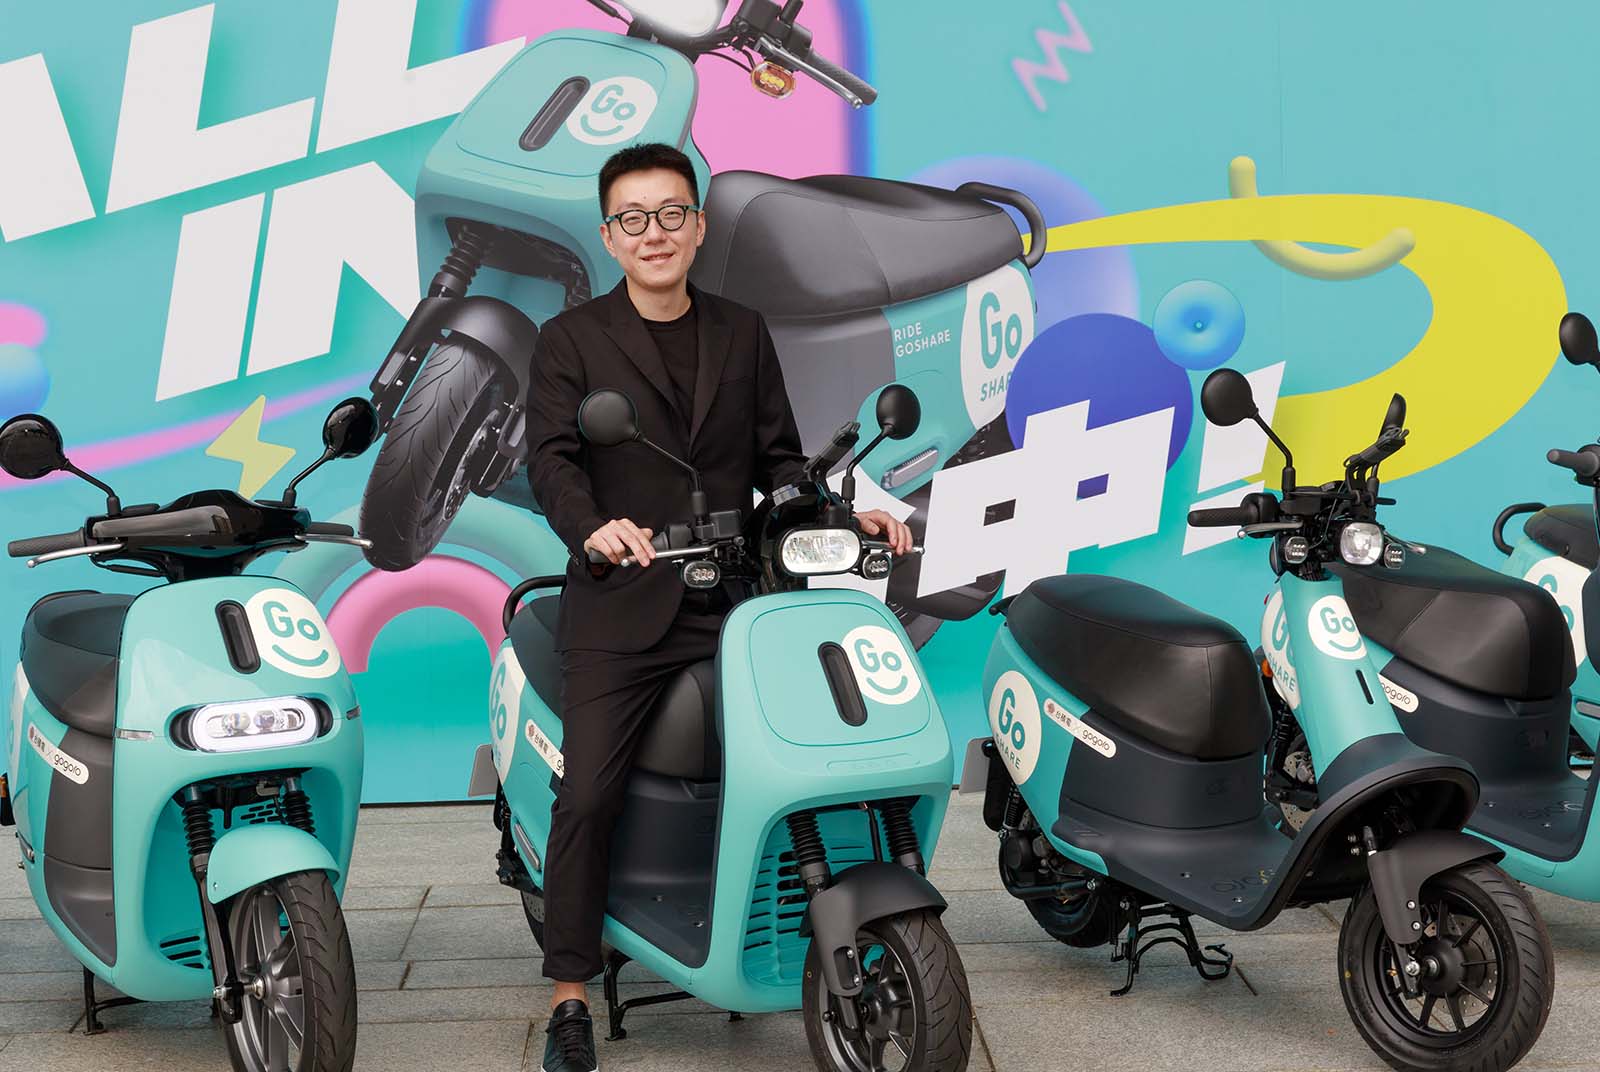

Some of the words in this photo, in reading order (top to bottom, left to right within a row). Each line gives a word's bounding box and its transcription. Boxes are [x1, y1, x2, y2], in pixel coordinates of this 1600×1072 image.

[591, 84, 637, 121] Go
[155, 161, 421, 402] IN
[894, 322, 923, 342] RIDE
[895, 329, 951, 358] GOSHARE
[980, 291, 1022, 369] Go
[262, 601, 321, 642] Go
[1320, 606, 1356, 634] Go
[854, 638, 902, 673] Go
[1268, 652, 1297, 692] SHARE
[998, 687, 1026, 751] Go
[995, 733, 1021, 769] SHARE
[1082, 729, 1110, 751] gogoro
[54, 754, 82, 777] gogoro
